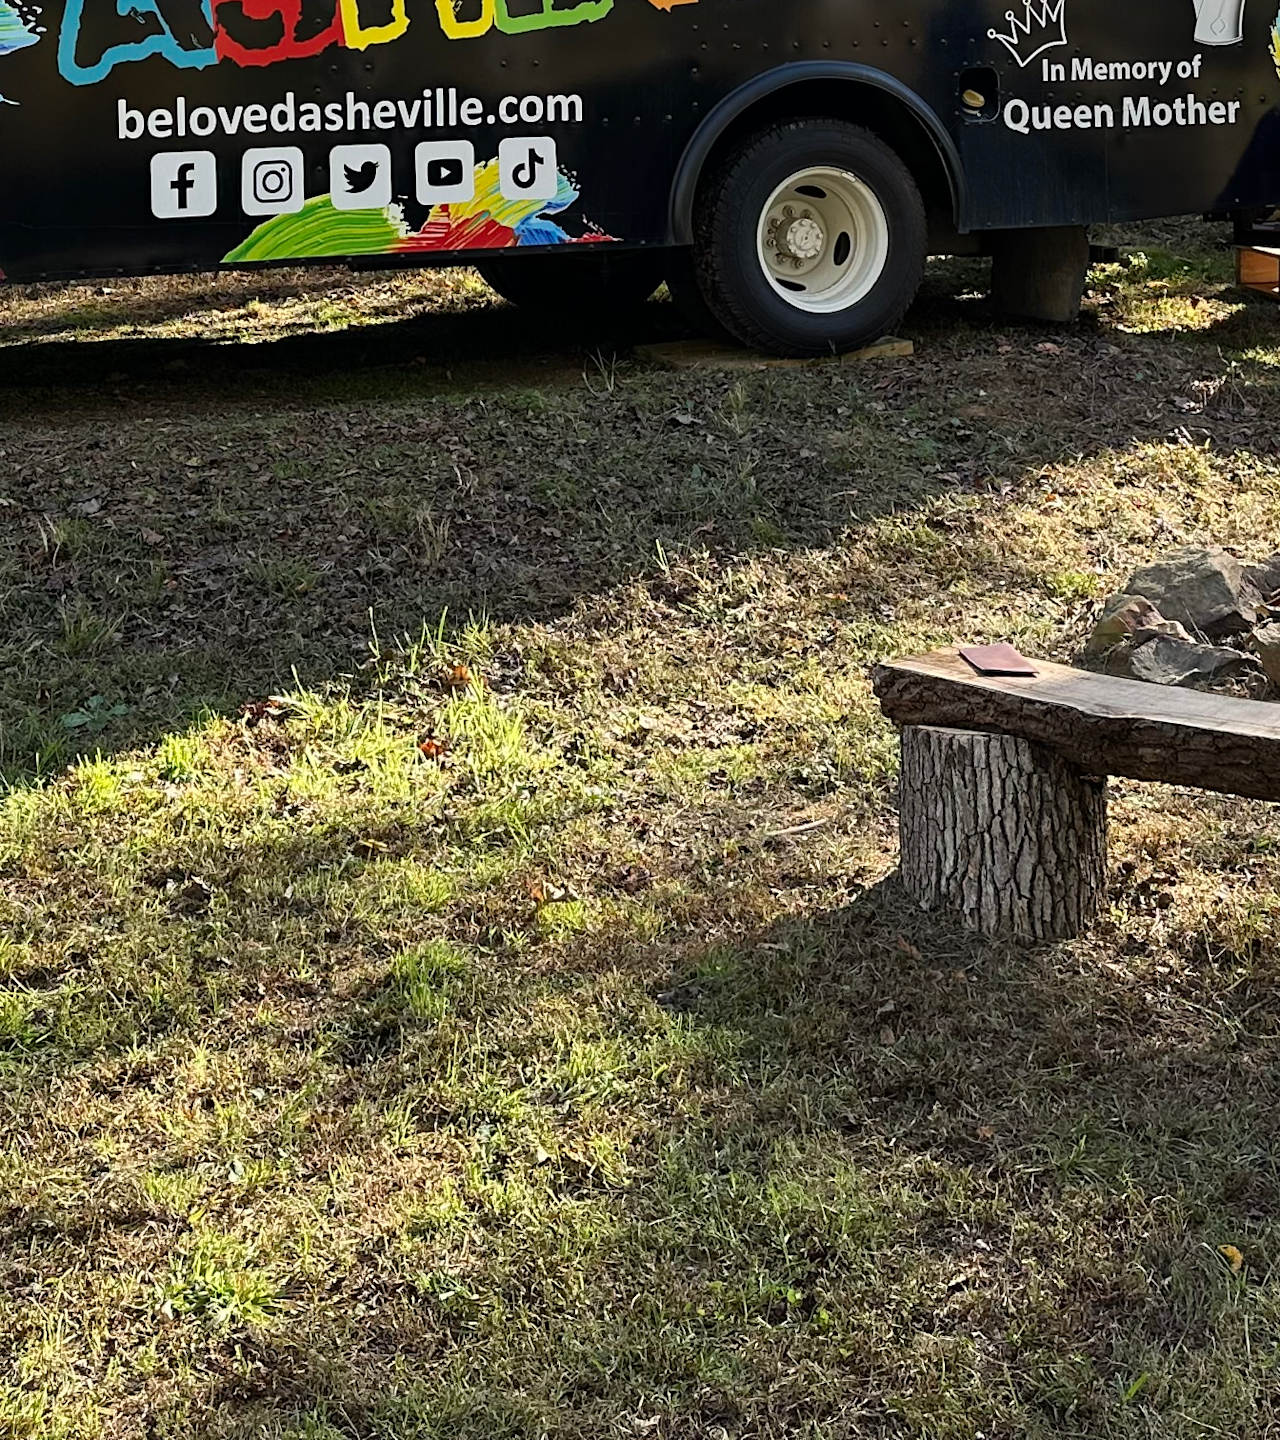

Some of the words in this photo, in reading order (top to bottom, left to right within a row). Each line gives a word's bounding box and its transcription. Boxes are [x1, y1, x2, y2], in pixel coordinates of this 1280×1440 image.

[1042, 58, 1065, 82] In
[1070, 57, 1173, 86] Memory
[1176, 53, 1203, 79] of
[116, 87, 584, 140] belovedasheville.com
[1002, 97, 1115, 135] Queen
[1121, 93, 1241, 128] Mother
